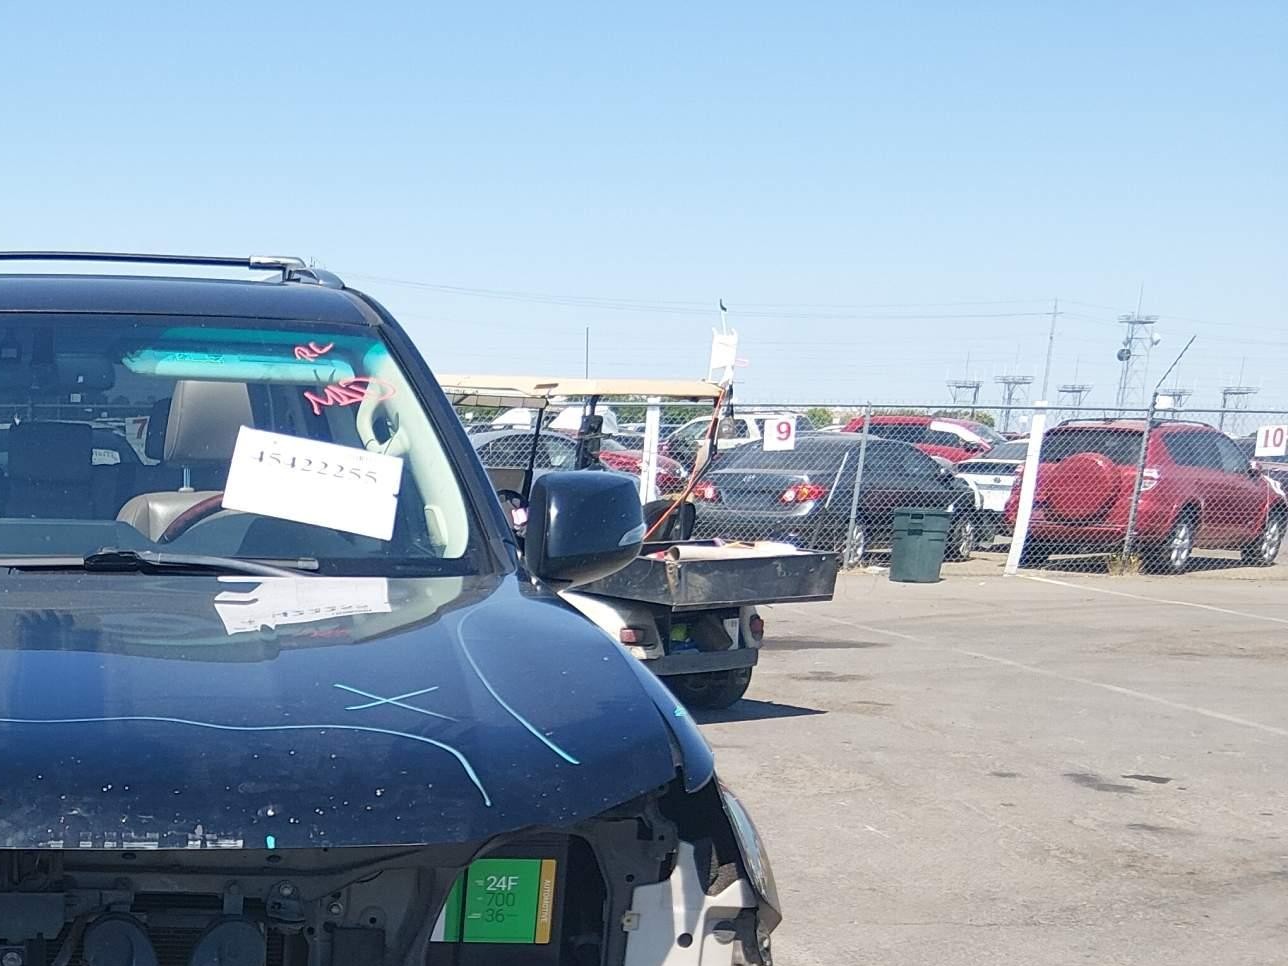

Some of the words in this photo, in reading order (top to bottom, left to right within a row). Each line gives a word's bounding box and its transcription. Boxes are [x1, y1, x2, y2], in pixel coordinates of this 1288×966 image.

[132, 418, 148, 440] 7
[776, 421, 791, 441] 9
[1263, 427, 1284, 448] 10
[486, 875, 520, 891] 24F
[485, 892, 515, 907] 700
[484, 908, 505, 923] 36
